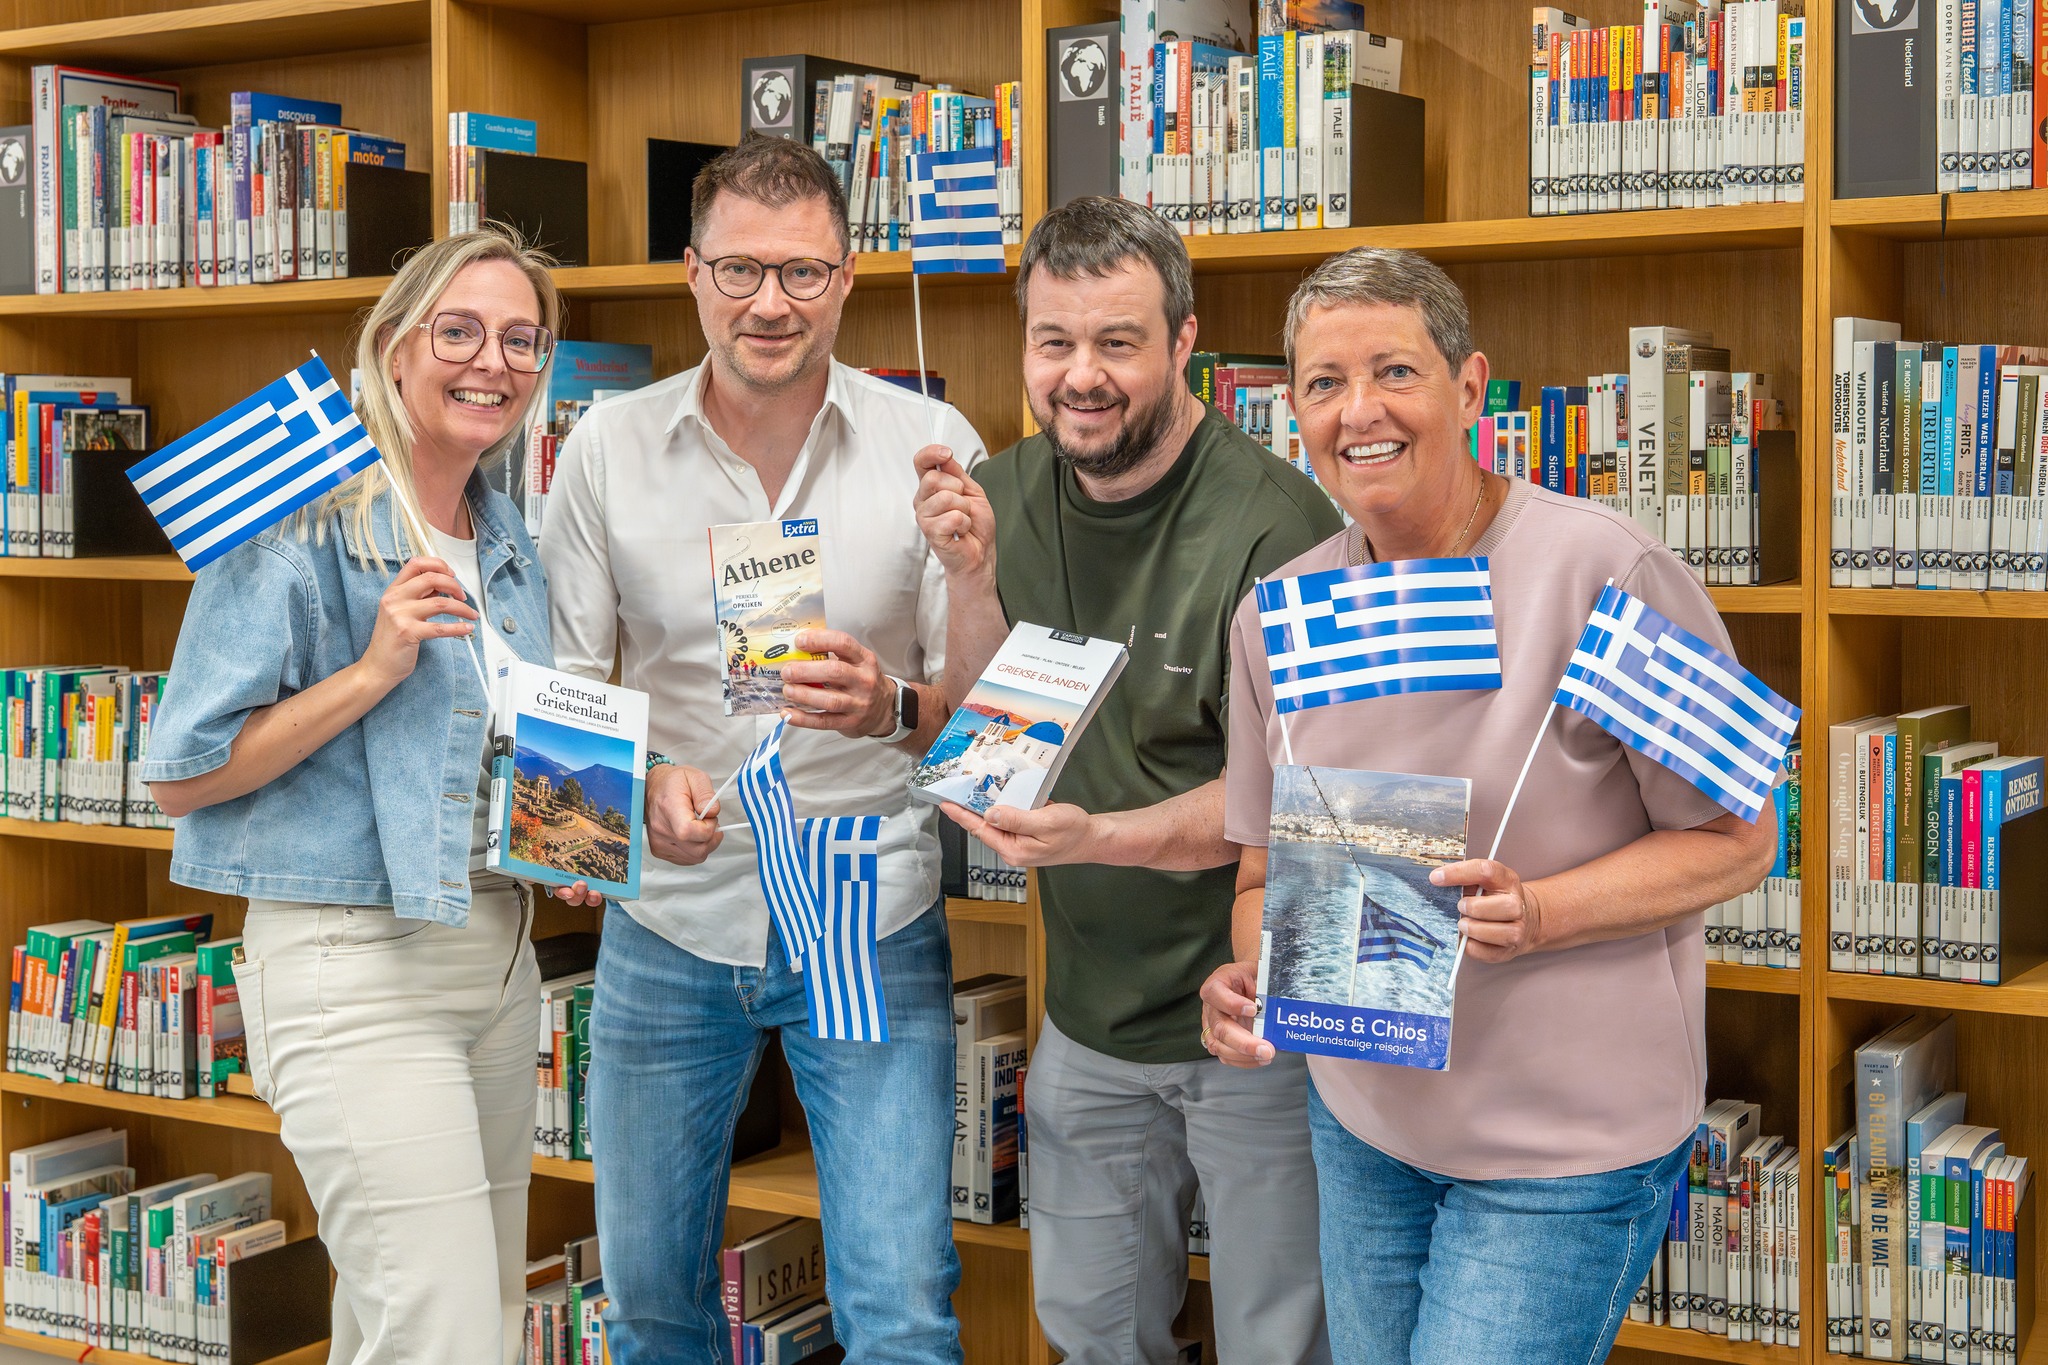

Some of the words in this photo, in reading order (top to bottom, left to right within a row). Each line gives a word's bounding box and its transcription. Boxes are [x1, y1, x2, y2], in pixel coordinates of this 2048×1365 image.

[1664, 5, 1680, 24] Lago
[1262, 41, 1277, 80] ITALIË
[1731, 44, 1736, 52] IN
[1905, 38, 1913, 86] Nederland
[1986, 22, 1994, 94] ACHTERTUIN
[101, 96, 139, 109] Trotter
[1130, 65, 1144, 122] ITALIË
[1286, 75, 1294, 123] EILANDEN
[1646, 97, 1654, 119] Lago
[1686, 96, 1692, 104] 10
[1764, 90, 1772, 112] Valle
[278, 110, 316, 122] DISCOVER
[1180, 114, 1187, 123] LE
[1334, 108, 1343, 138] ITALIË
[1286, 125, 1294, 144] VAN
[235, 133, 244, 182] FRANCE
[353, 151, 385, 165] motor
[42, 146, 50, 216] FRANKRIJK
[576, 358, 628, 373] Wanderlust
[1904, 360, 1910, 368] DE
[1834, 374, 1842, 433] AUTOROUTES
[1842, 371, 1850, 432] TOERISTISCHE
[1857, 372, 1866, 444] WIJNROUTES
[1881, 407, 1887, 415] op
[1879, 418, 1889, 472] Nederland
[1944, 417, 1952, 471] BUCKETLIST
[1961, 424, 1971, 458] FRITS.
[533, 425, 542, 493] Wanderlust
[1549, 456, 1558, 487] Sicilië
[1619, 456, 1628, 492] UMBRIË
[1639, 423, 1655, 495] VENET
[1736, 455, 1746, 494] VENETIË
[1836, 439, 1848, 491] Nederland
[1979, 448, 1987, 491] NEDERLAND
[1694, 474, 1702, 494] Vene
[784, 524, 816, 538] Extra
[723, 549, 816, 588] Athene
[997, 664, 1038, 680] GRIEKSE
[1038, 674, 1090, 691] EILANDEN
[1164, 664, 1193, 674] Creativity
[536, 692, 618, 724] Griekenland
[550, 680, 606, 706] Centraal
[1838, 752, 1851, 782] One
[1904, 762, 1912, 797] ESCAPES
[2009, 772, 2037, 797] RENSKE
[1885, 798, 1893, 833] onderweg
[2006, 790, 2040, 816] ONTDEKT
[1872, 804, 1880, 857] BUCKETLIST
[1927, 812, 1938, 856] GROEN
[25, 961, 33, 1001] Languedoc
[35, 964, 45, 1003] Languedoc
[1276, 1007, 1345, 1032] Lesbos
[1351, 1016, 1365, 1034] &
[1371, 1020, 1427, 1041] Chios
[1286, 1030, 1372, 1052] Nederlandstalige
[1374, 1042, 1414, 1055] reisgids
[995, 1053, 1009, 1068] HET
[1869, 1114, 1887, 1186] EILANDEN
[1908, 1158, 1919, 1175] DE
[200, 1201, 218, 1221] DE
[1871, 1193, 1887, 1208] IN
[1908, 1180, 1919, 1238] WADDEN
[130, 1205, 138, 1232] TUINEN
[1872, 1215, 1888, 1233] DE
[15, 1228, 24, 1268] PARIJ
[129, 1247, 138, 1273] PARIJS
[176, 1225, 186, 1282] PROVENCE
